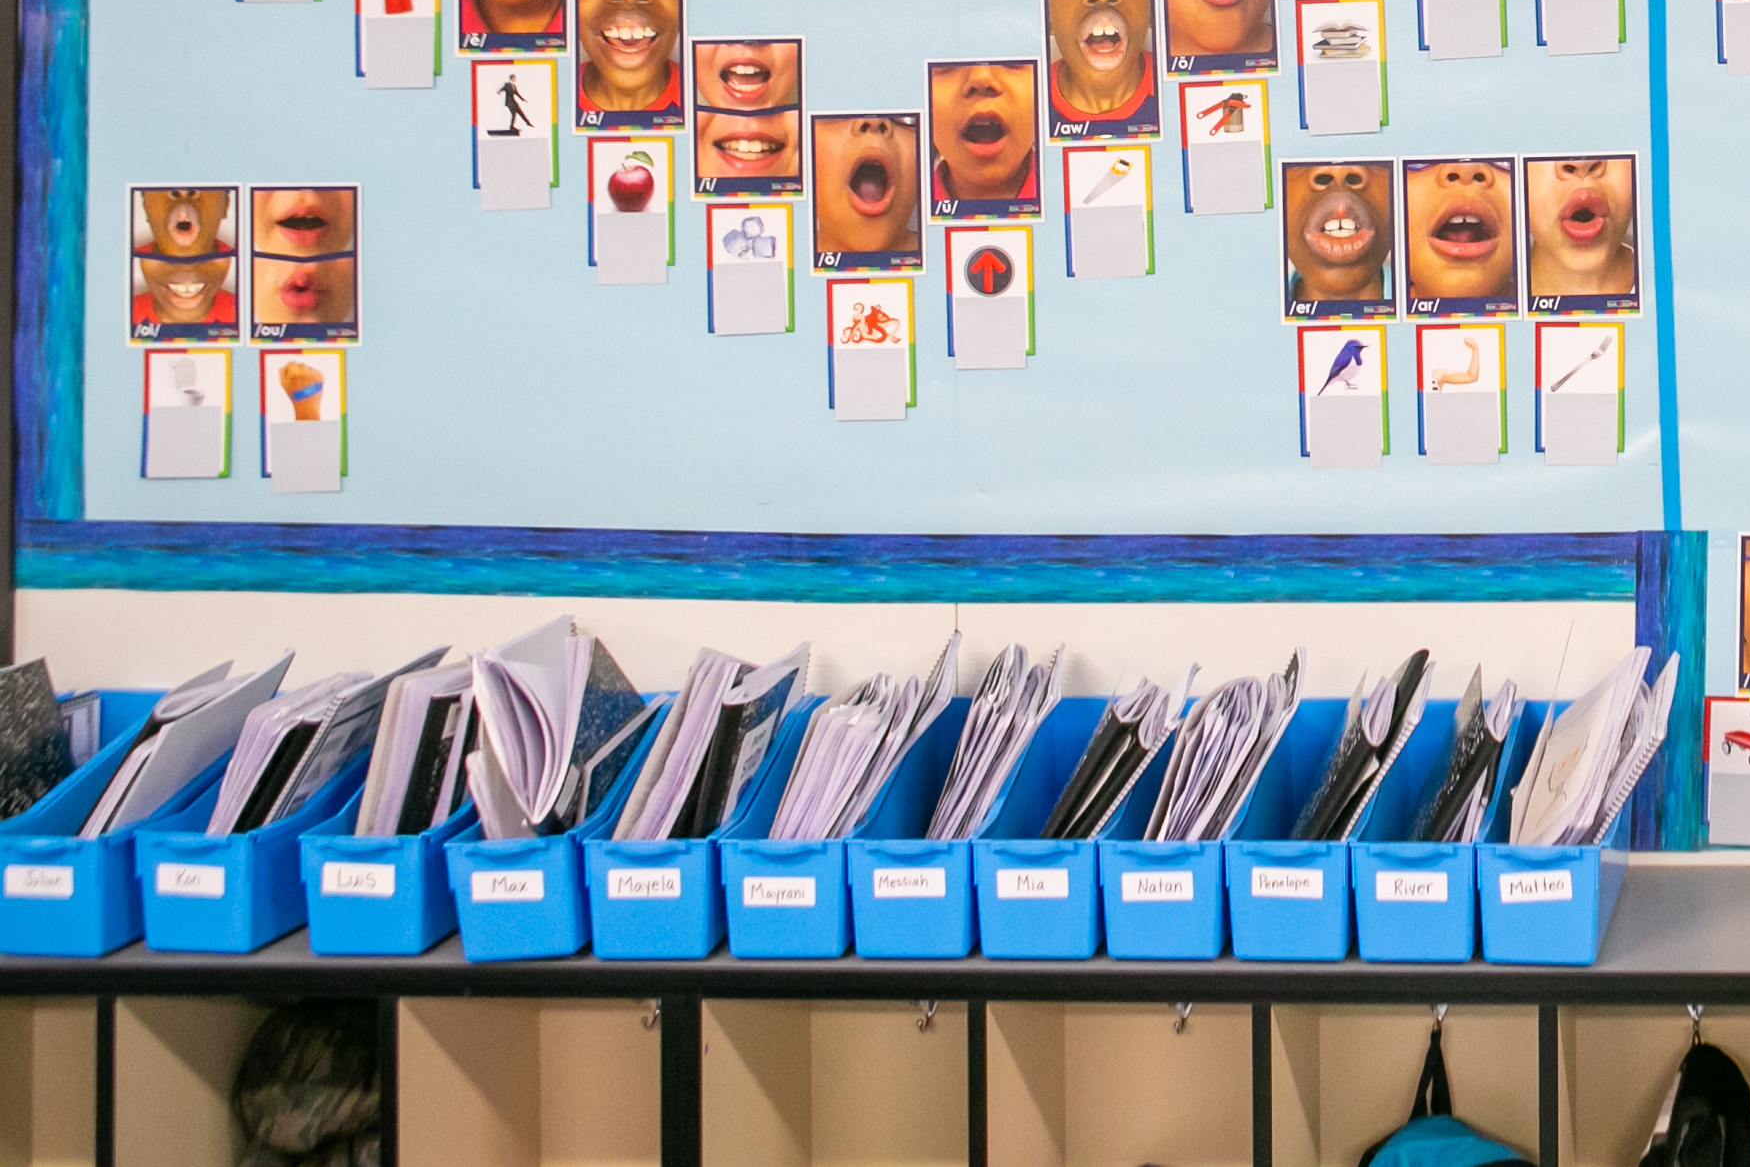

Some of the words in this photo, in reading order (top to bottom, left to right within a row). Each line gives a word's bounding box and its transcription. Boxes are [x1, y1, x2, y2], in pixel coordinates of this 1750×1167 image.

[1054, 121, 1089, 136] /aw/
[1289, 301, 1318, 315] /er/
[1411, 298, 1440, 312] /ar/
[1531, 296, 1561, 310] /or/
[255, 323, 287, 338] /ou/
[337, 868, 377, 889] Luis
[492, 875, 528, 893] Max
[618, 875, 675, 897] Mayela
[878, 873, 929, 889] Messiah
[1017, 874, 1045, 892] Mia
[1138, 877, 1183, 894] Natan
[1259, 873, 1310, 892] Penelope
[1394, 878, 1434, 896] River
[1510, 876, 1565, 896] Matteo
[751, 882, 805, 905] Mayrani
